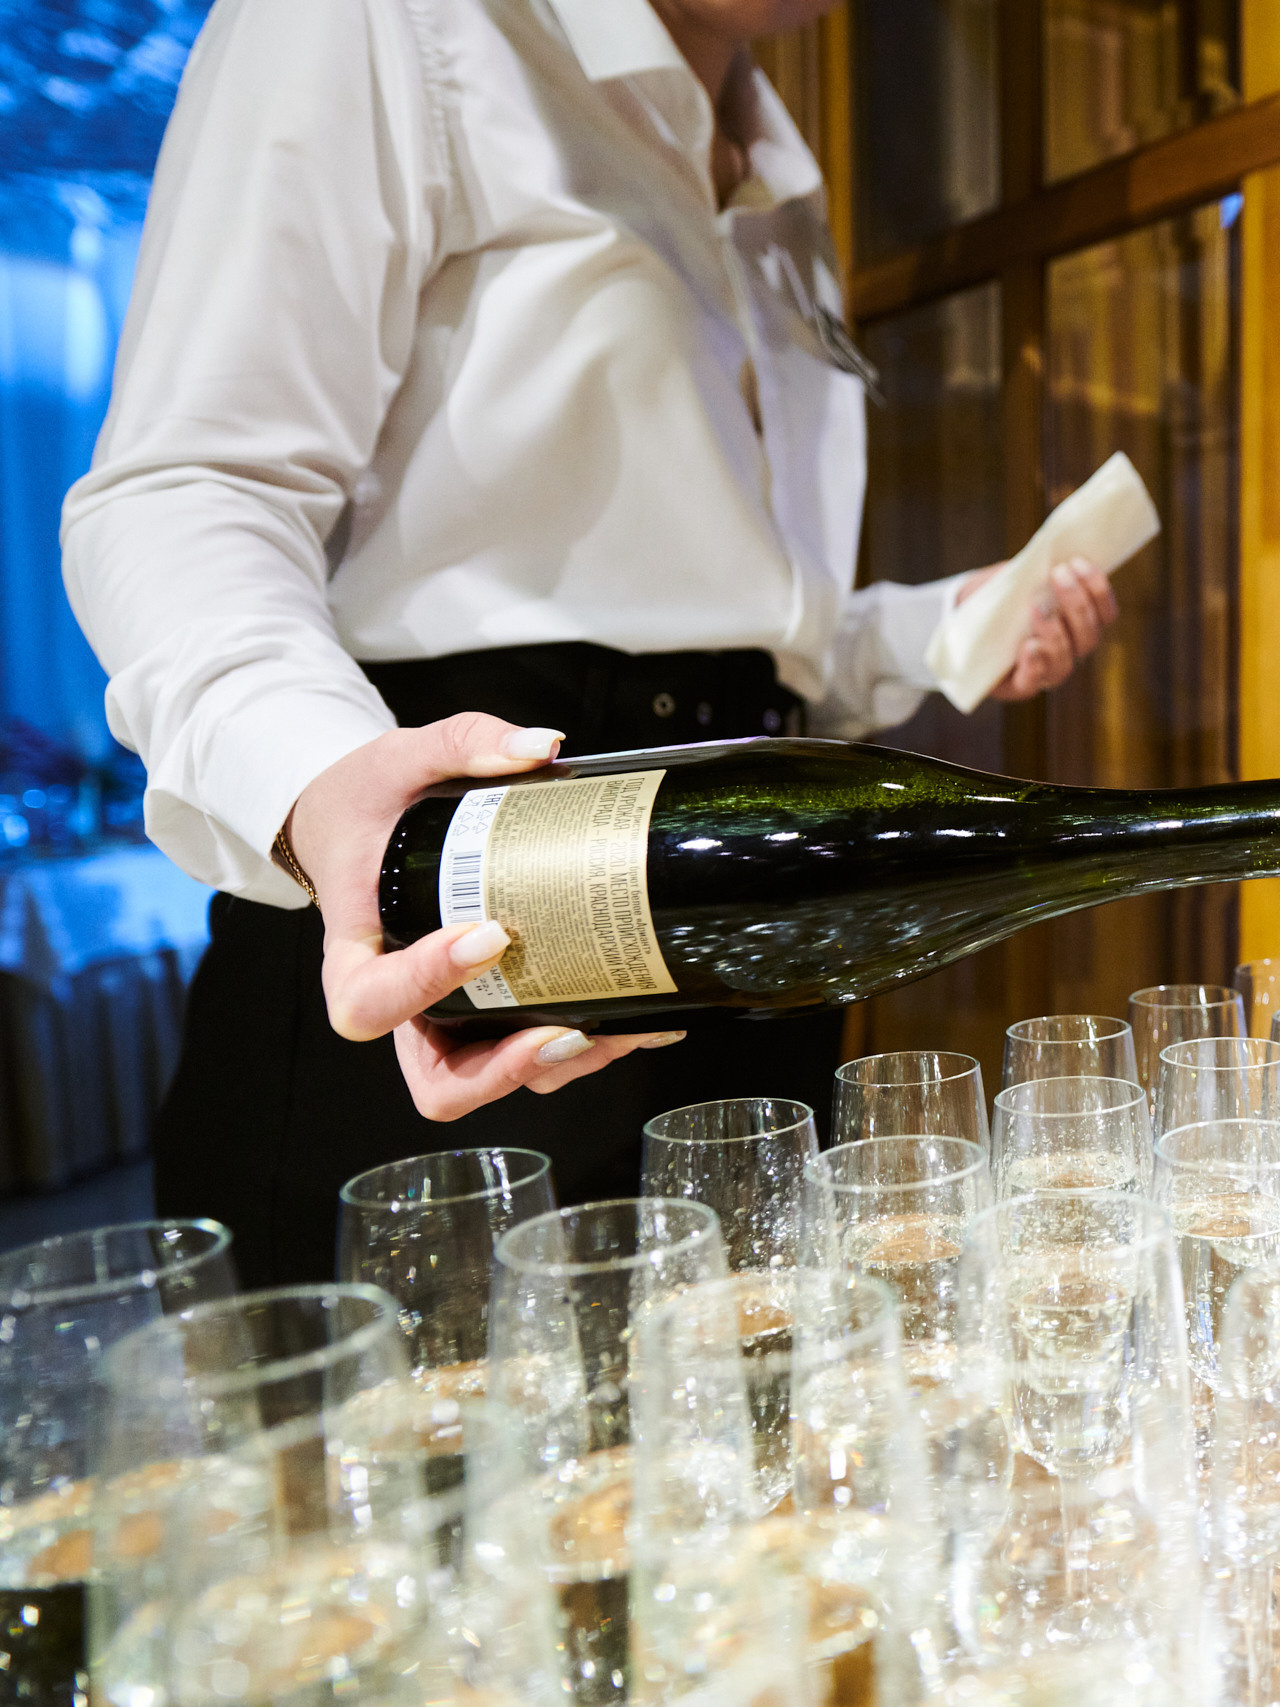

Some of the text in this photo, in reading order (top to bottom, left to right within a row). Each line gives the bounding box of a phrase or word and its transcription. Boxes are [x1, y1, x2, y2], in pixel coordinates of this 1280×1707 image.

[592, 780, 624, 827] ВИНОГРАДА
[620, 778, 644, 793] ГОД
[613, 794, 638, 830] УРОЖАЯ
[631, 806, 646, 842] Игристое
[586, 838, 607, 881] РОССИЯ,
[609, 842, 628, 870] 2020.
[610, 872, 630, 908] МЕСТО
[627, 866, 640, 887] брют
[631, 890, 641, 915] белое
[589, 883, 624, 966] КРАСНОДАРСКИЙ
[635, 918, 651, 954] «Ариант»
[614, 910, 657, 990] ПРОИСХОЖДЕНИЯ
[607, 968, 636, 990] КРАЙ.
